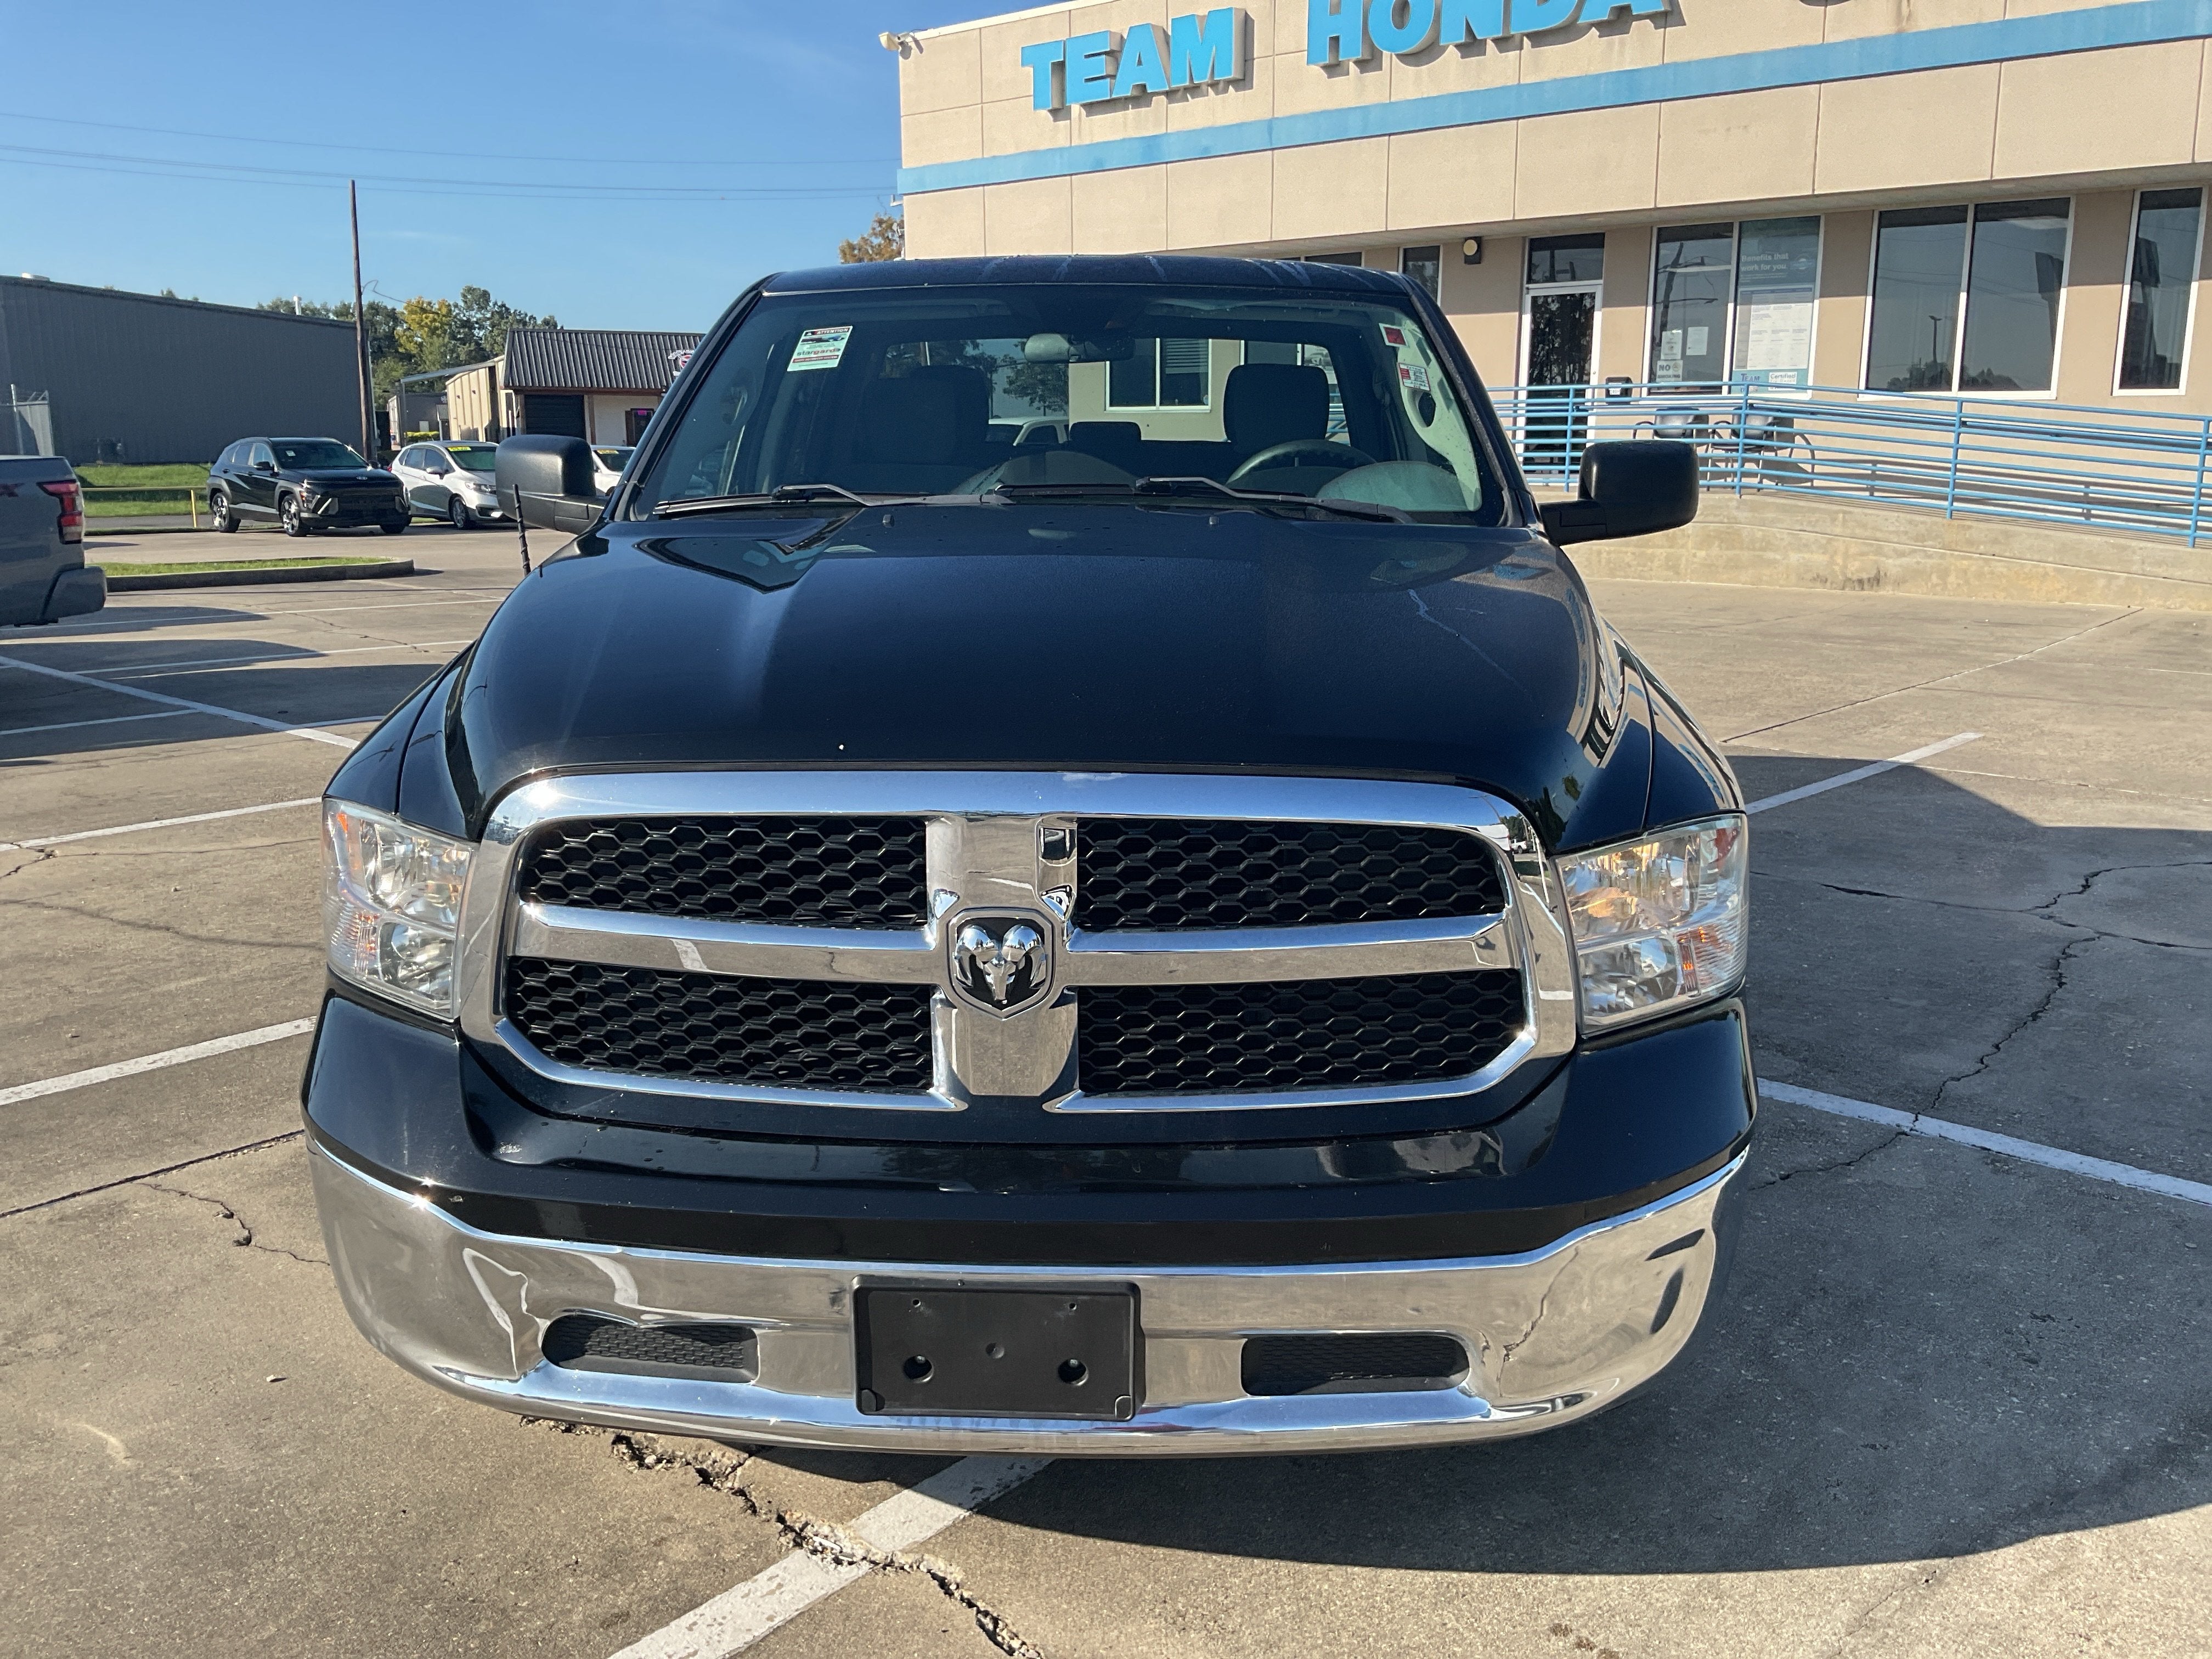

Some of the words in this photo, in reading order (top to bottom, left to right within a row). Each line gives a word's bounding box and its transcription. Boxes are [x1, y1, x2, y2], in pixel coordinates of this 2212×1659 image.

[1021, 7, 1239, 111] TEAM
[1307, 0, 1667, 65] HON
[1741, 254, 1772, 262] Benefits
[1741, 263, 1759, 272] work
